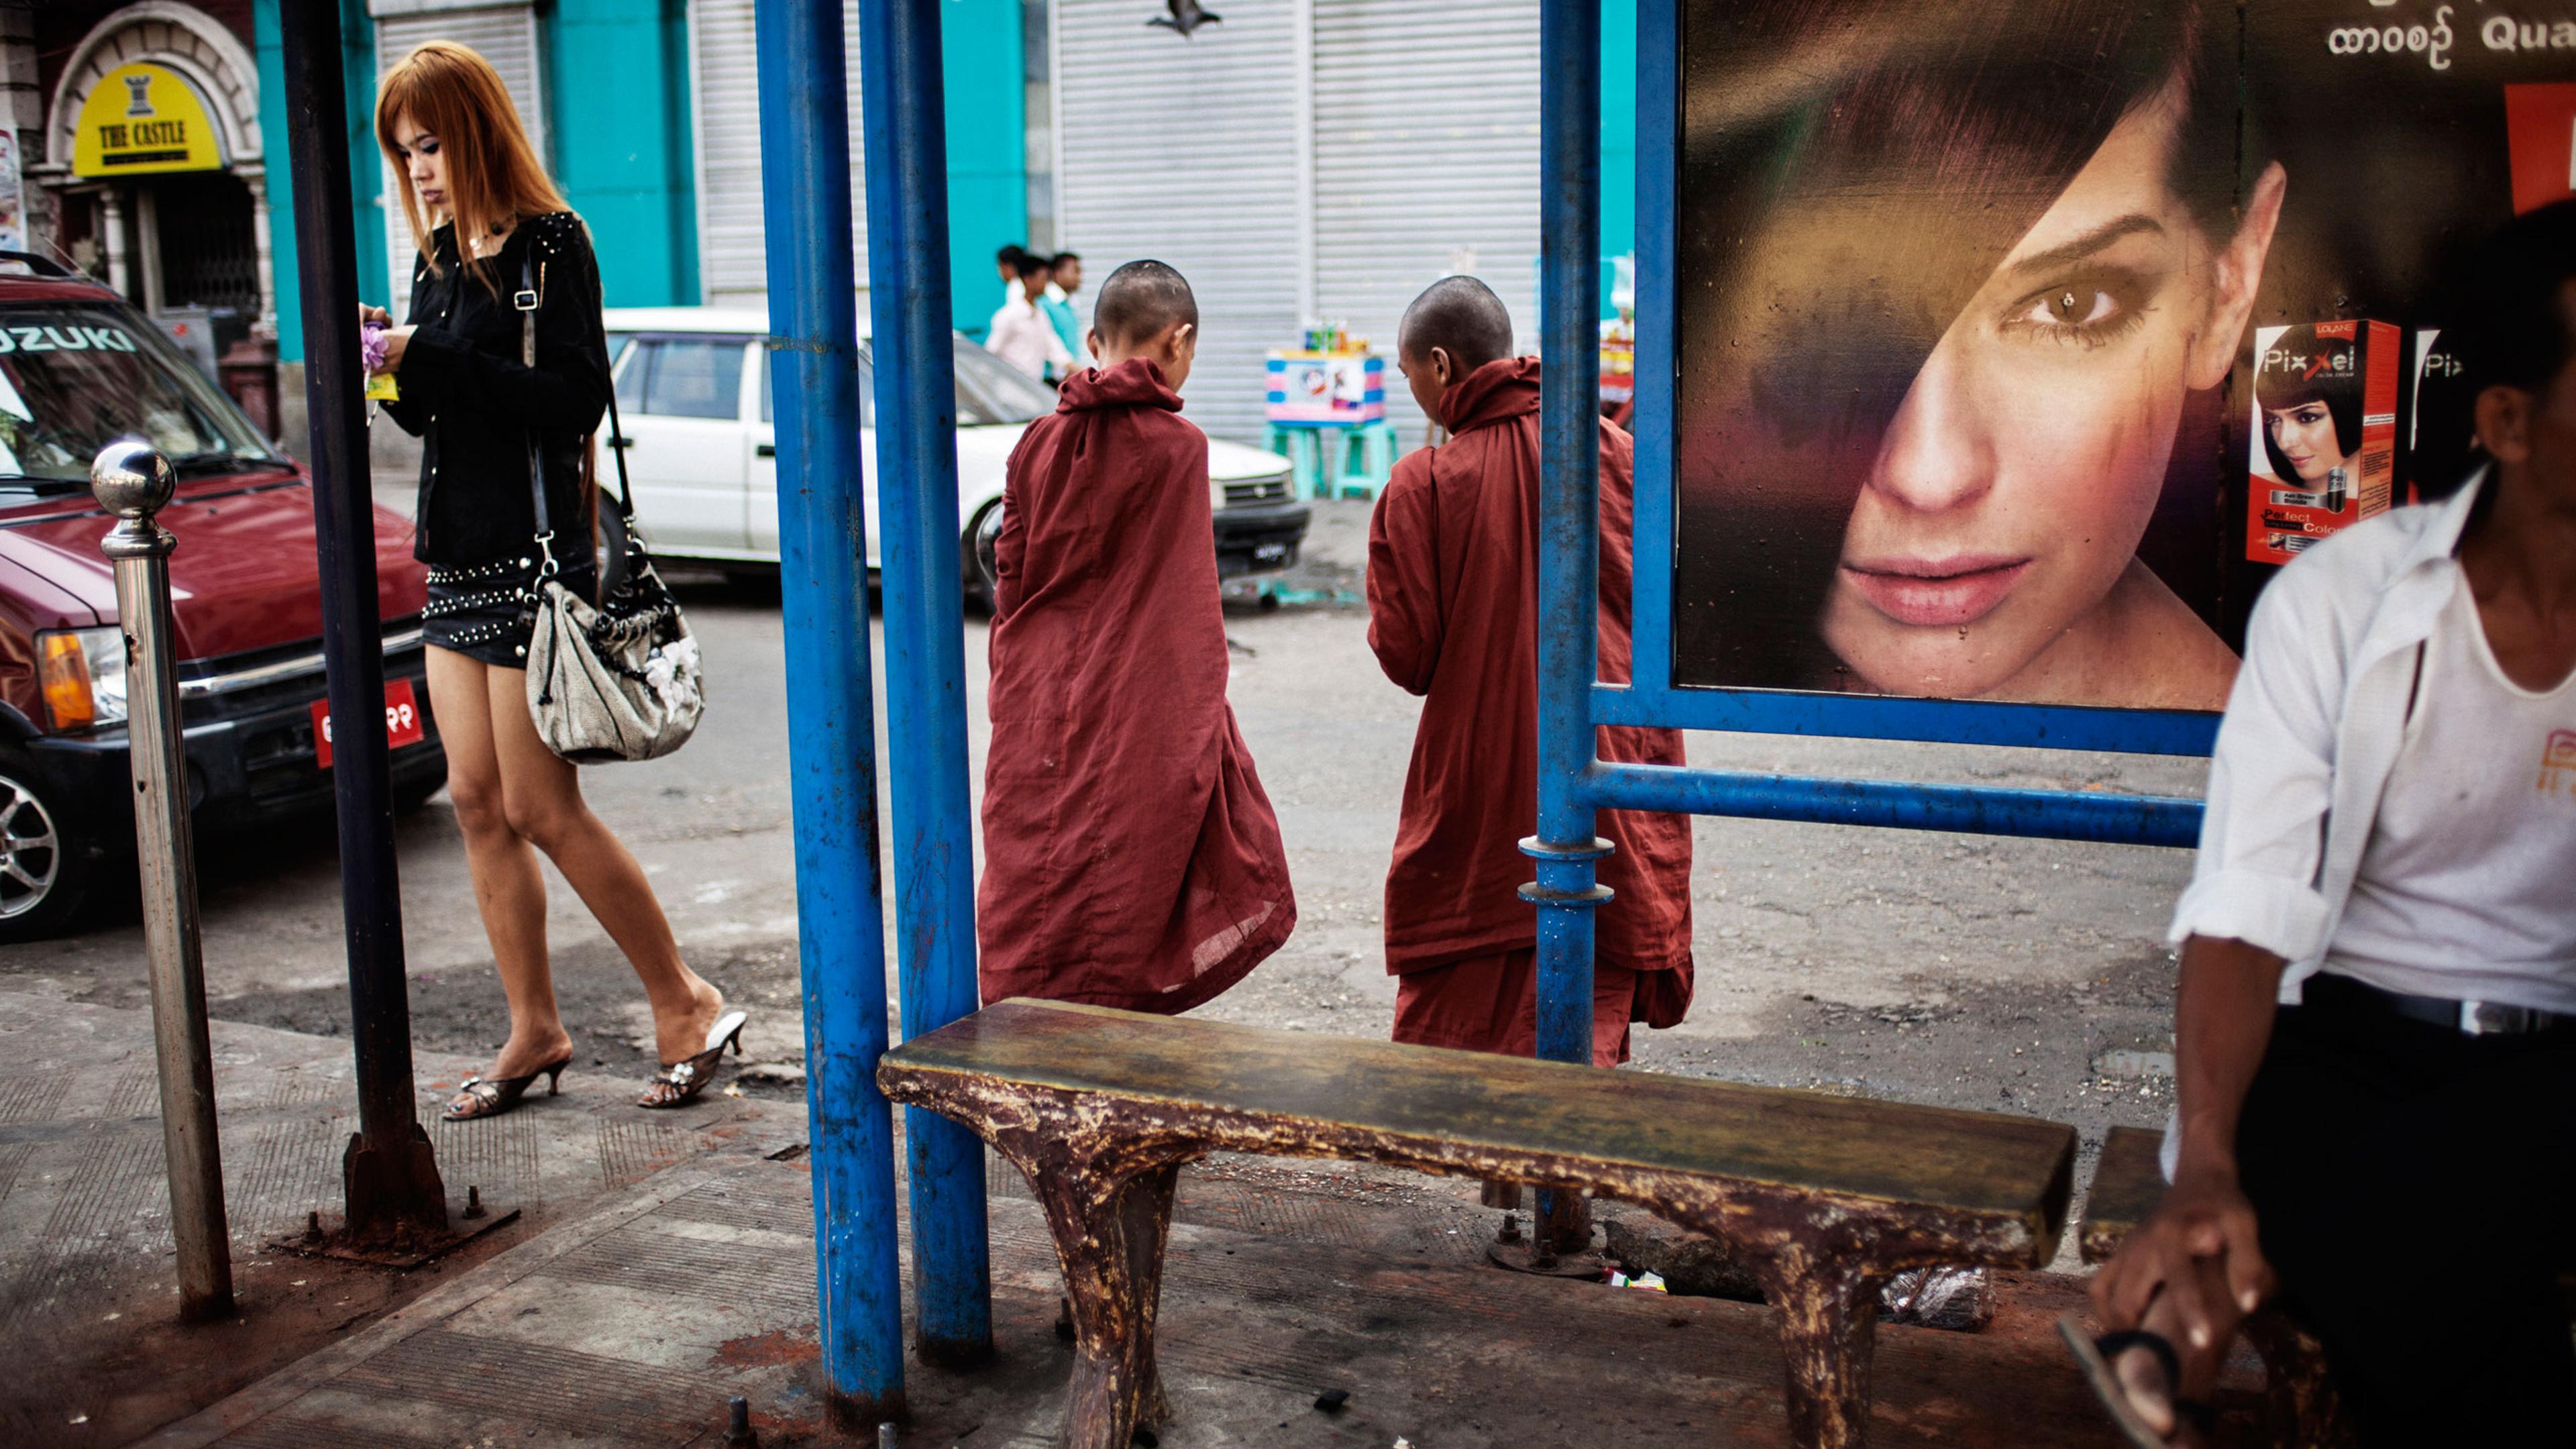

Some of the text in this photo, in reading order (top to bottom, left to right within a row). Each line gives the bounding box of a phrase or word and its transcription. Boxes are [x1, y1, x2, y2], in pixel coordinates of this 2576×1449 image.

[99, 120, 186, 148] THE CASTLE
[2261, 509, 2310, 522] Perfect
